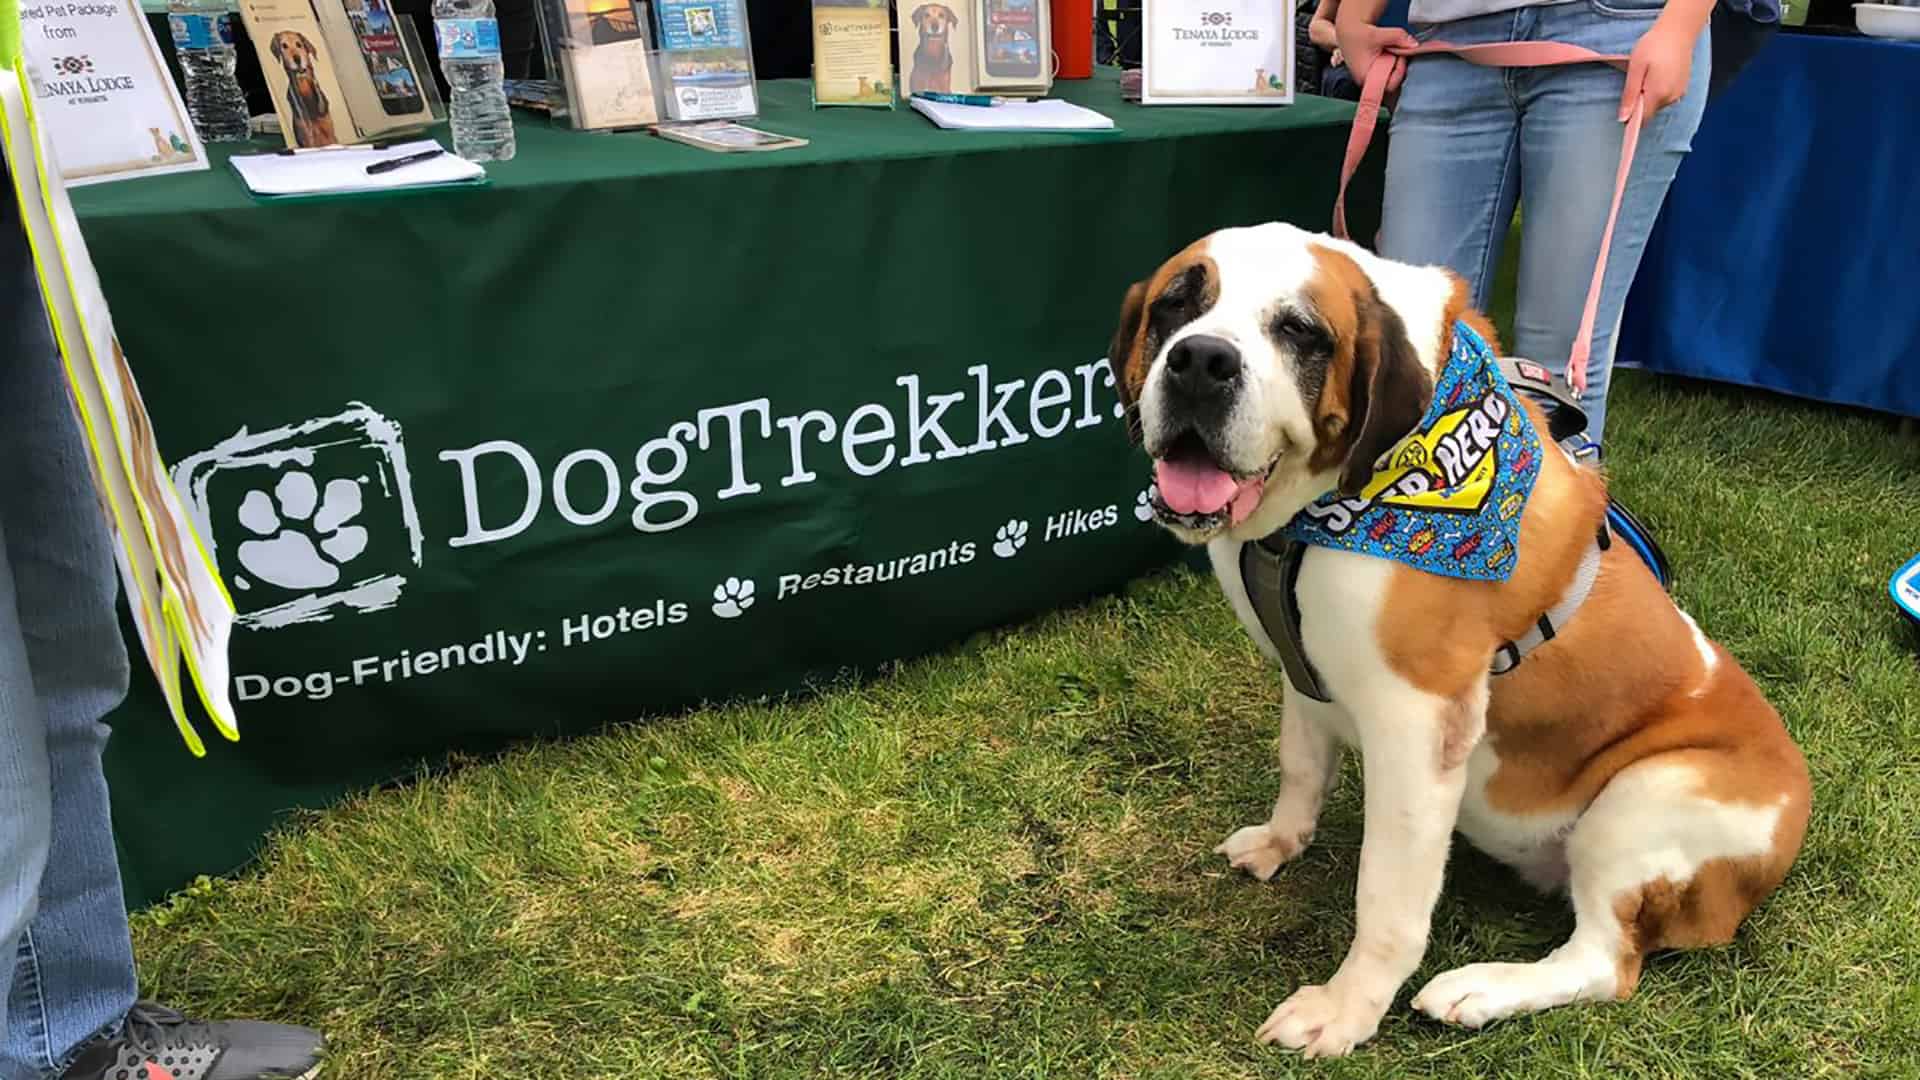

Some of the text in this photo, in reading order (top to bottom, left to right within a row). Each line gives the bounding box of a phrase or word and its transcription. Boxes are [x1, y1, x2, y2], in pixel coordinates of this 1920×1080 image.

[46, 5, 67, 17] Pet
[67, 3, 118, 18] Package
[43, 24, 77, 40] from
[1172, 27, 1259, 41] TENAYA LODGE
[87, 76, 135, 94] LODGE
[1434, 393, 1506, 488] HERO
[234, 504, 1118, 701] Dog-Friendly: Hotels Restaurants Hikes
